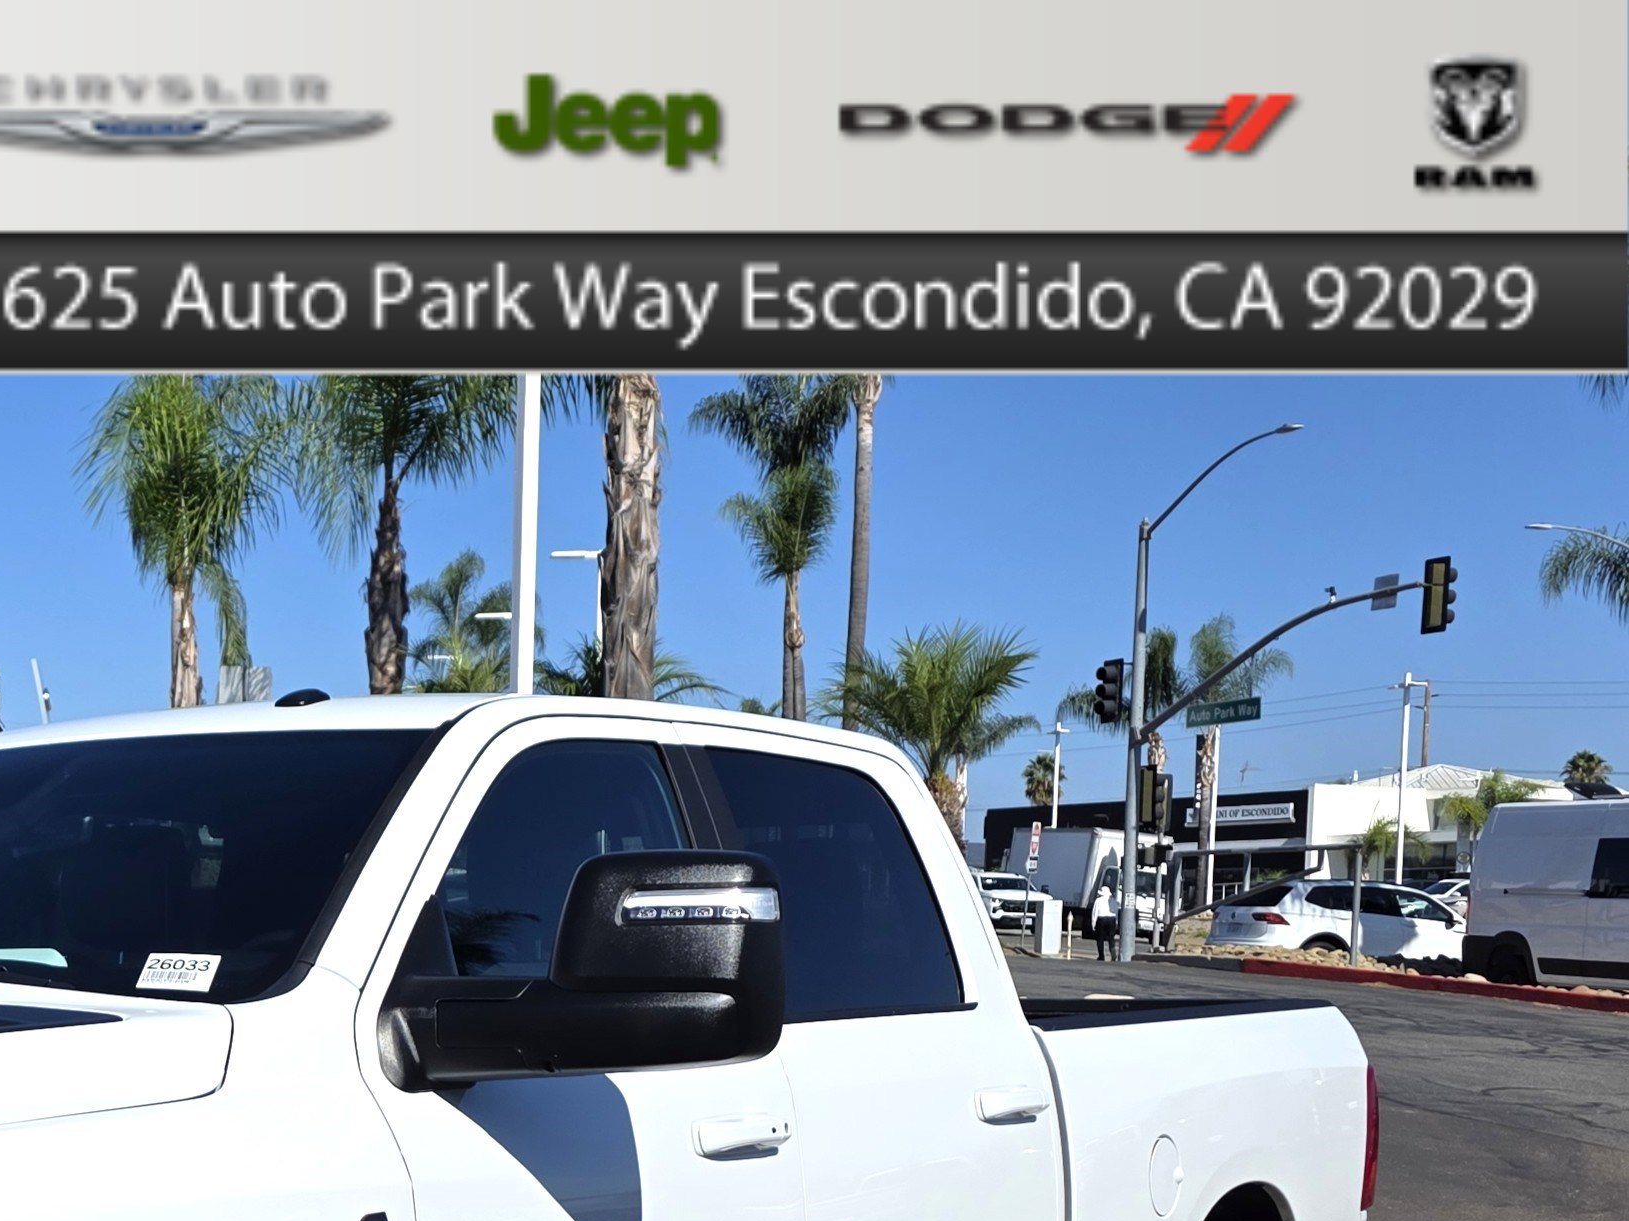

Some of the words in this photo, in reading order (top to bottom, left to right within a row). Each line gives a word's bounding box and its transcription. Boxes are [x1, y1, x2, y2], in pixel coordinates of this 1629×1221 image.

[1189, 710, 1211, 722] Auto
[1214, 706, 1235, 719] Park
[1238, 703, 1258, 718] Way
[1229, 808, 1240, 818] OF
[1241, 806, 1289, 818] ESCONDIDO
[147, 958, 211, 972] 26033
